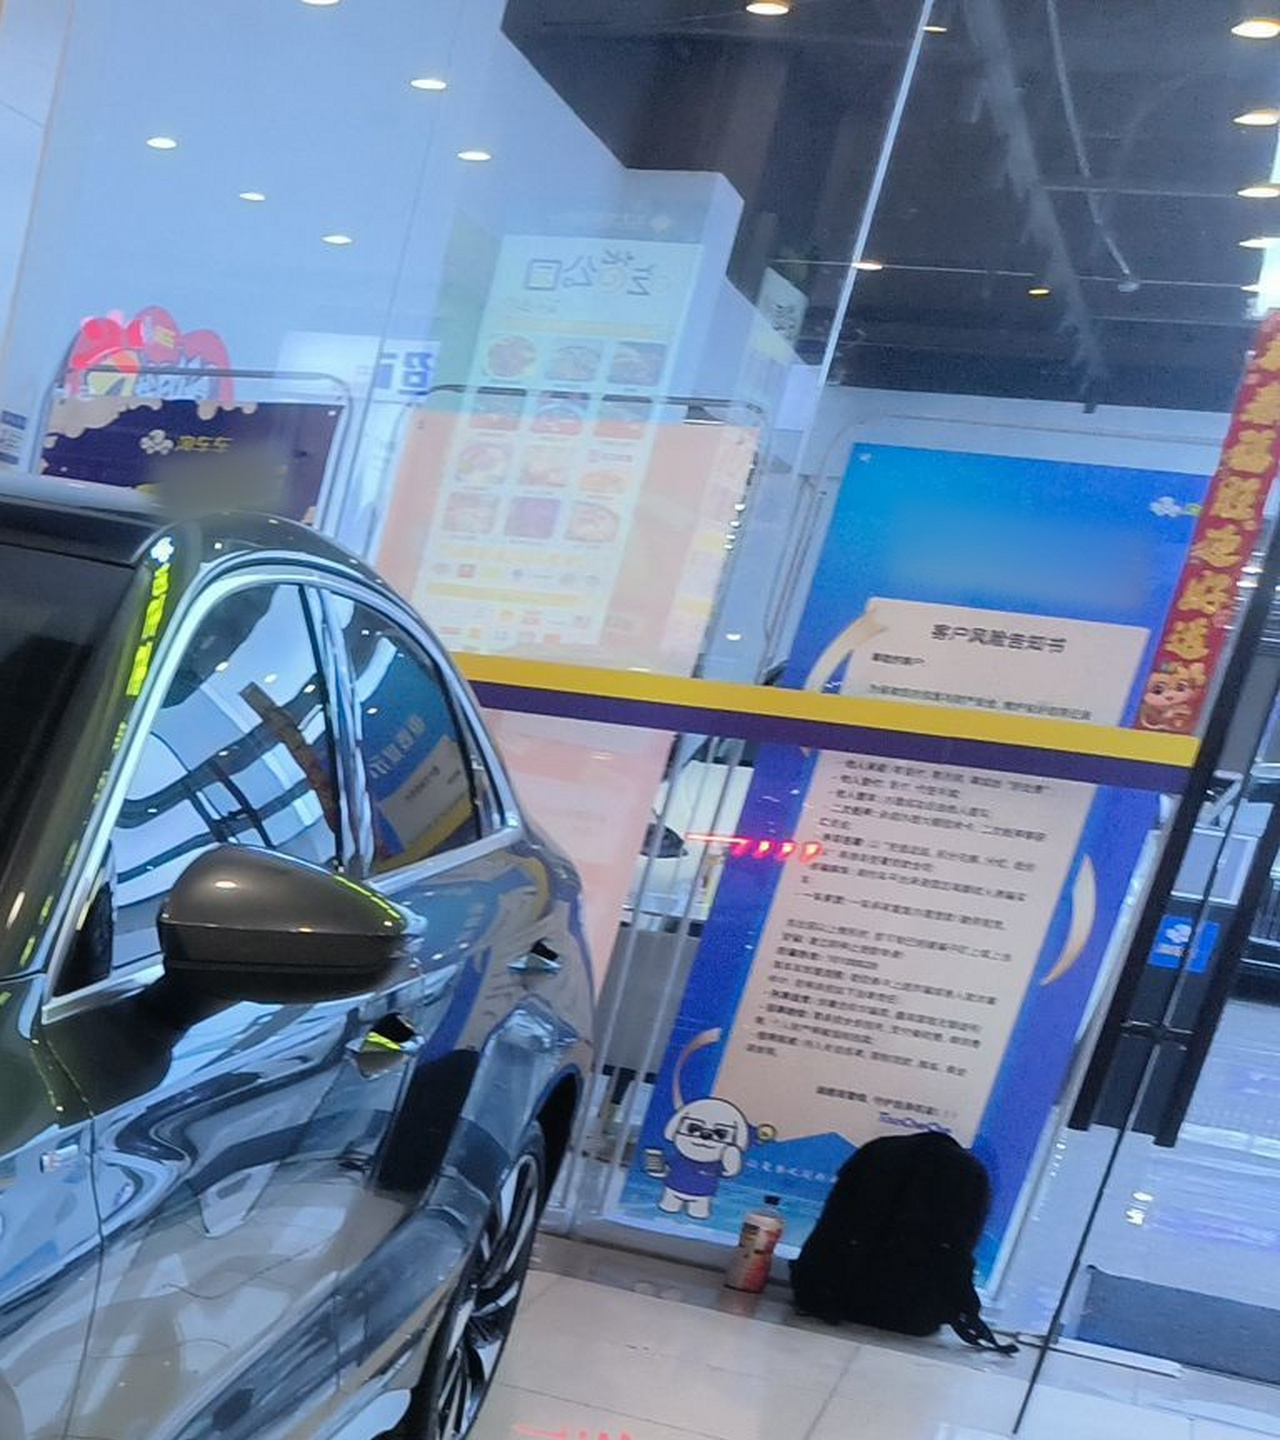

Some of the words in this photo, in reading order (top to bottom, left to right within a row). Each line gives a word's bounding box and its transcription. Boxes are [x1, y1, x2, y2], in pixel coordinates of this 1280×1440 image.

[930, 622, 1069, 654] 客户风险告知书
